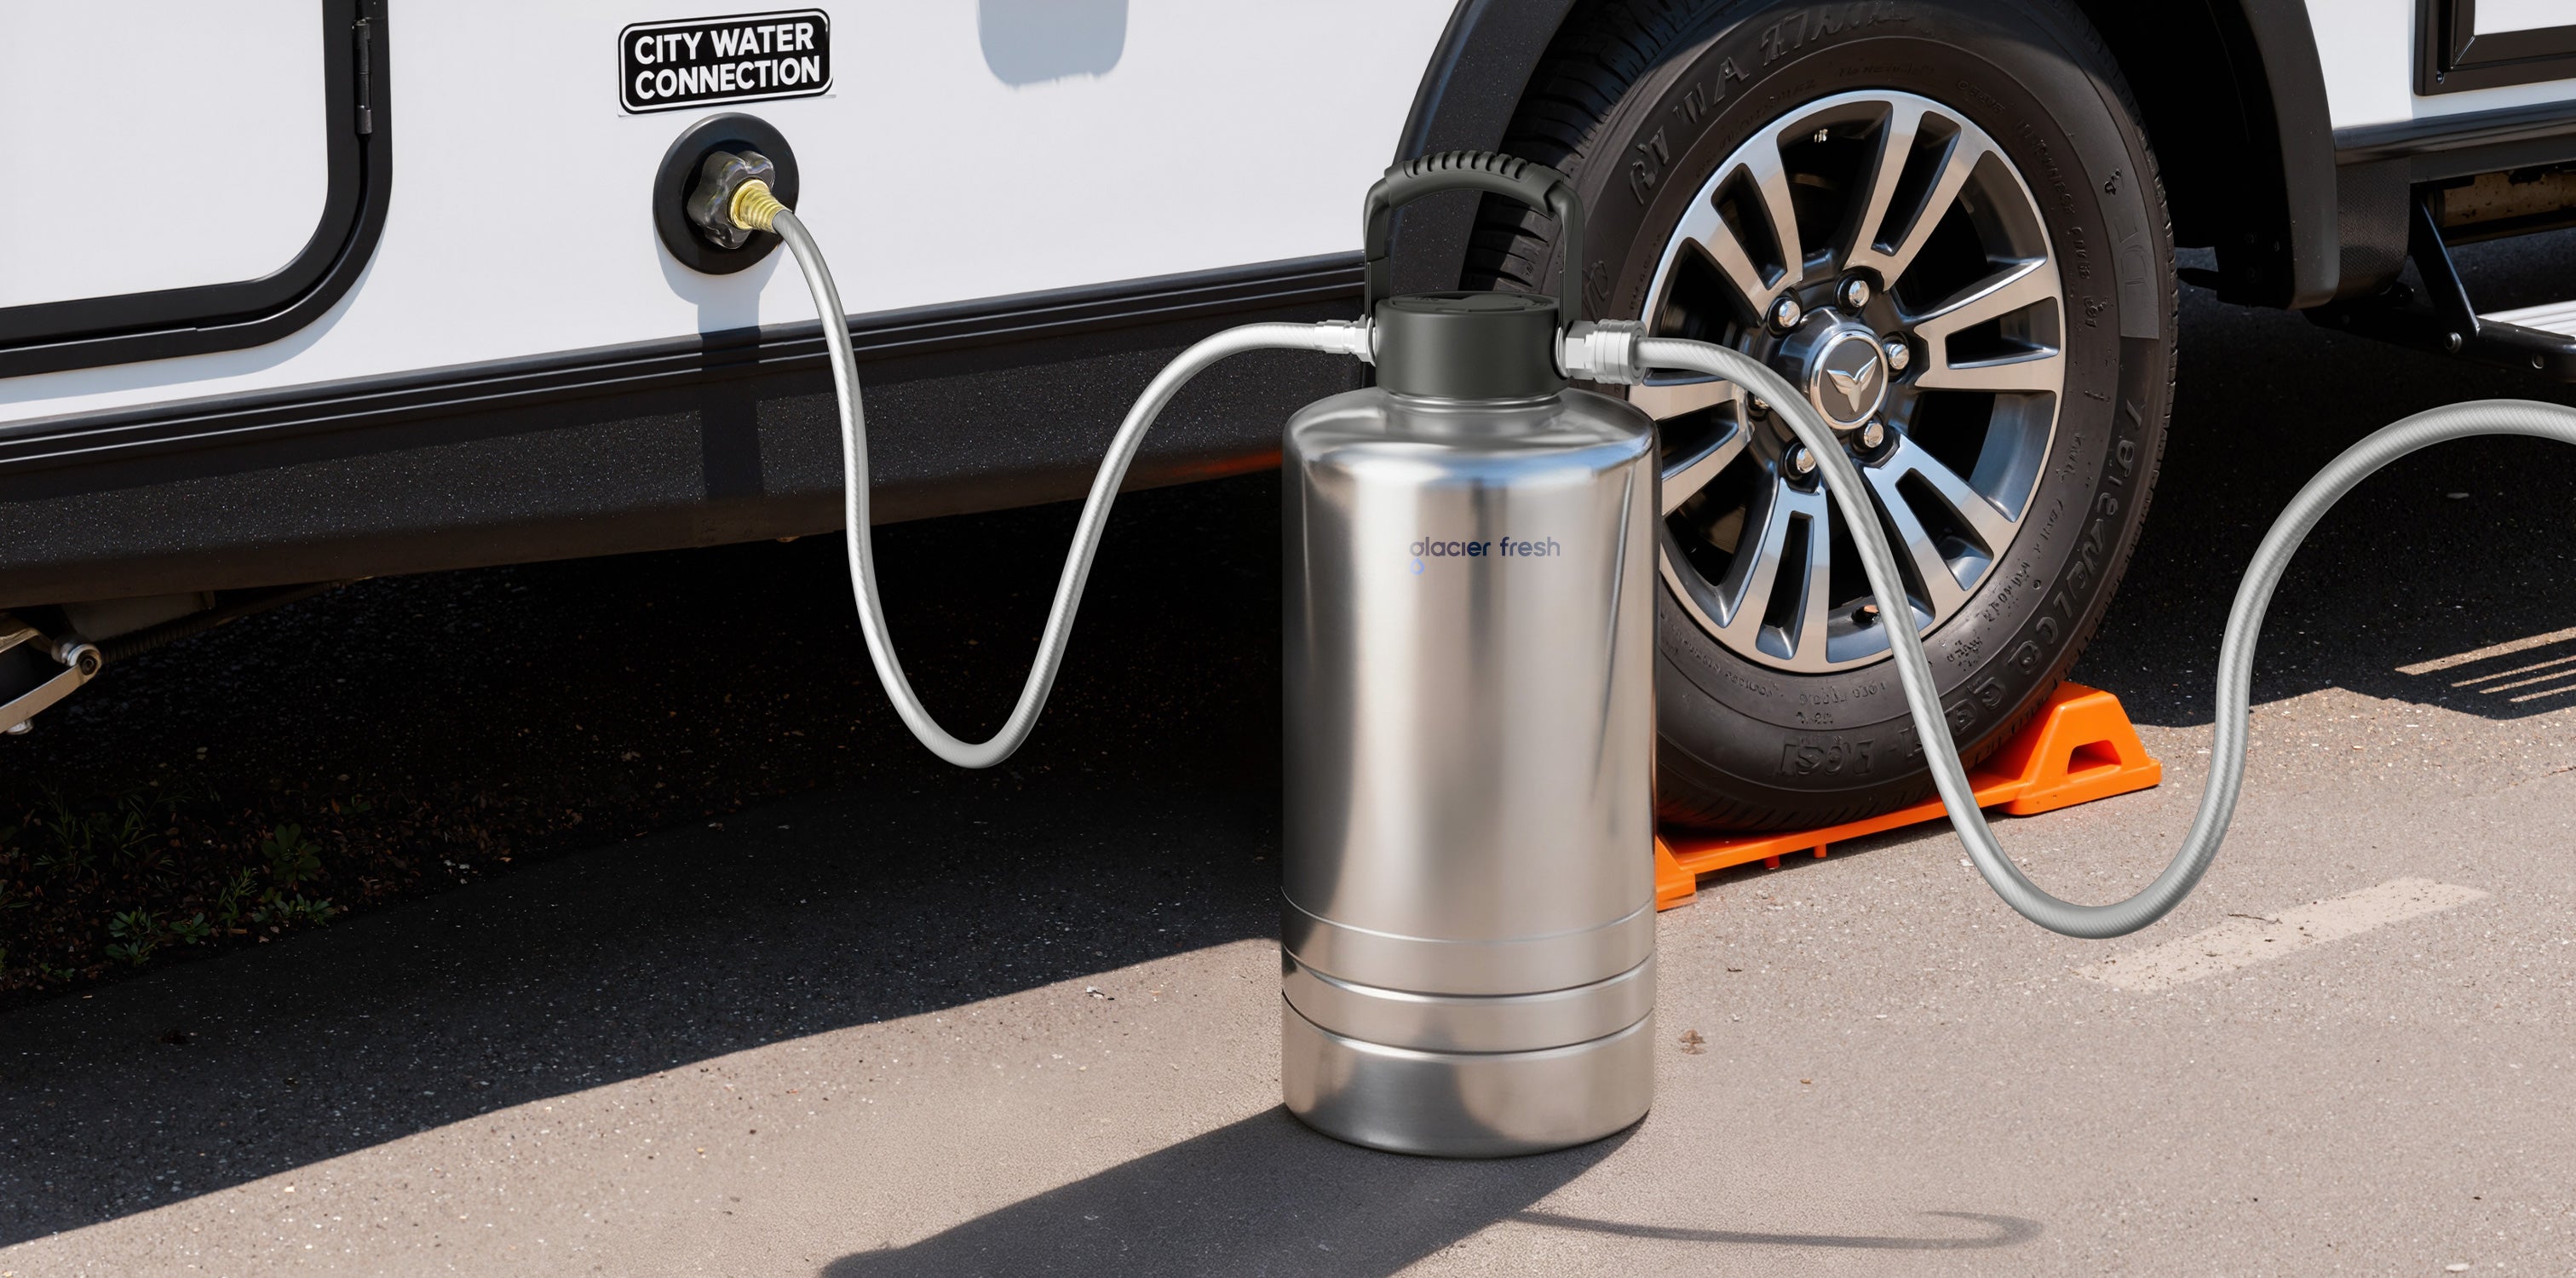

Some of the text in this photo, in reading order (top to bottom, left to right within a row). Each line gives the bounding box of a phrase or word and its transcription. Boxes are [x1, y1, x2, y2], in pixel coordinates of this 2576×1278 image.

[635, 23, 814, 65] CITY WATER
[636, 56, 819, 100] CONNECTION
[1410, 537, 1561, 574] glacier fresh
